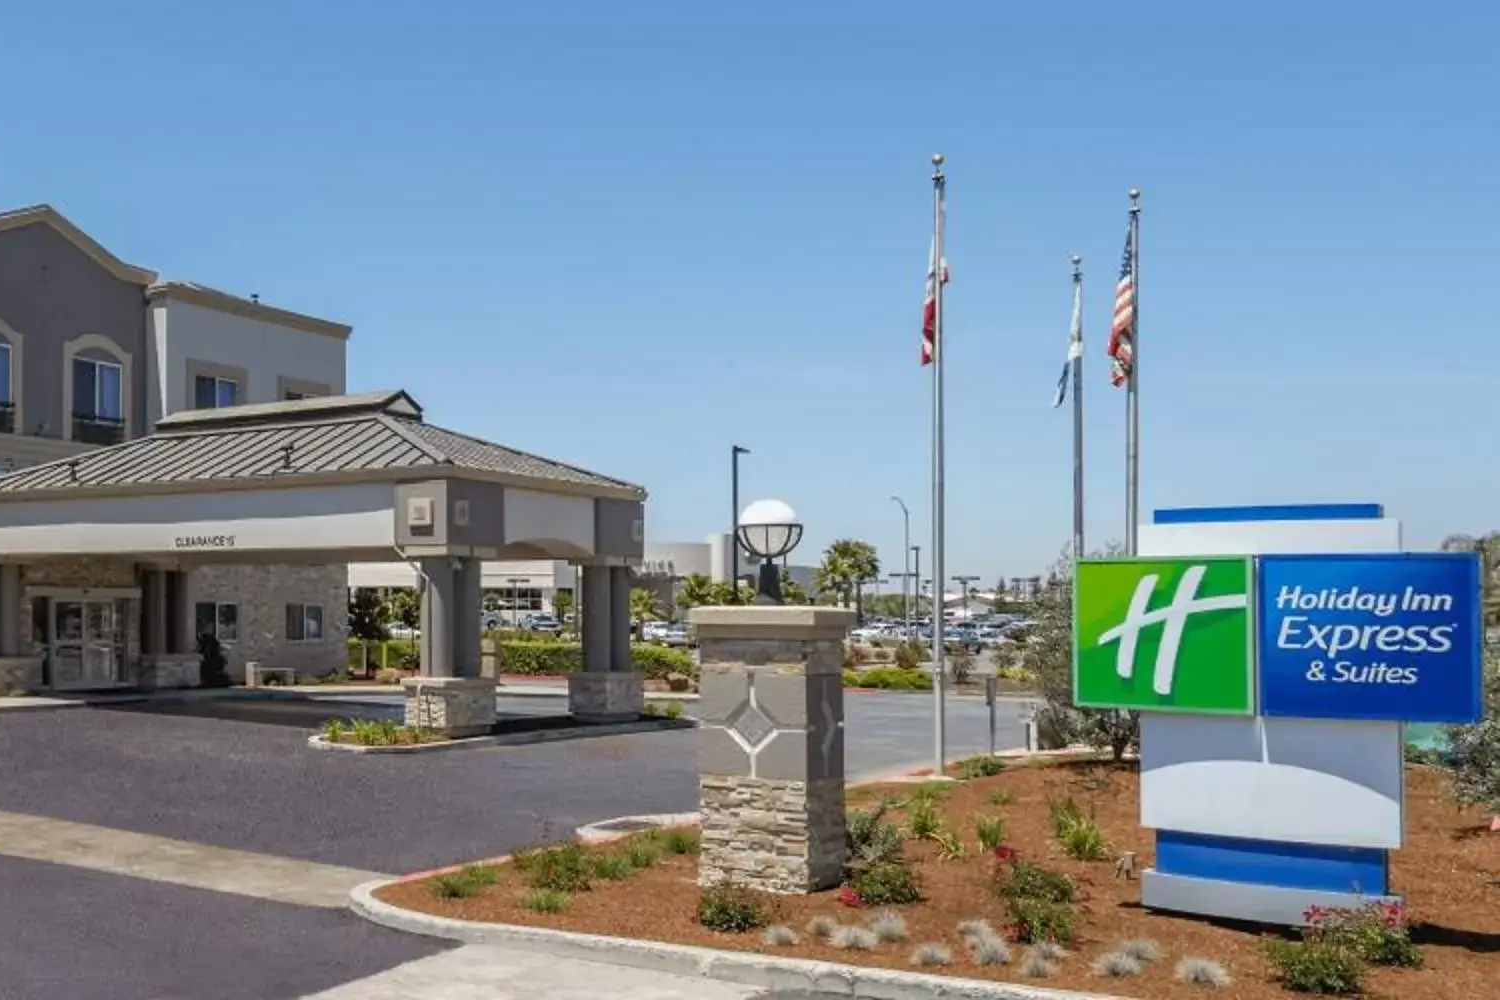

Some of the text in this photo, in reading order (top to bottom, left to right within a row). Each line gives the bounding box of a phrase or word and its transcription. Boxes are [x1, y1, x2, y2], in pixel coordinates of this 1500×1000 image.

[1276, 585, 1453, 617] Holiday Inn
[1277, 615, 1453, 660] Express
[1305, 660, 1418, 685] & Suites
